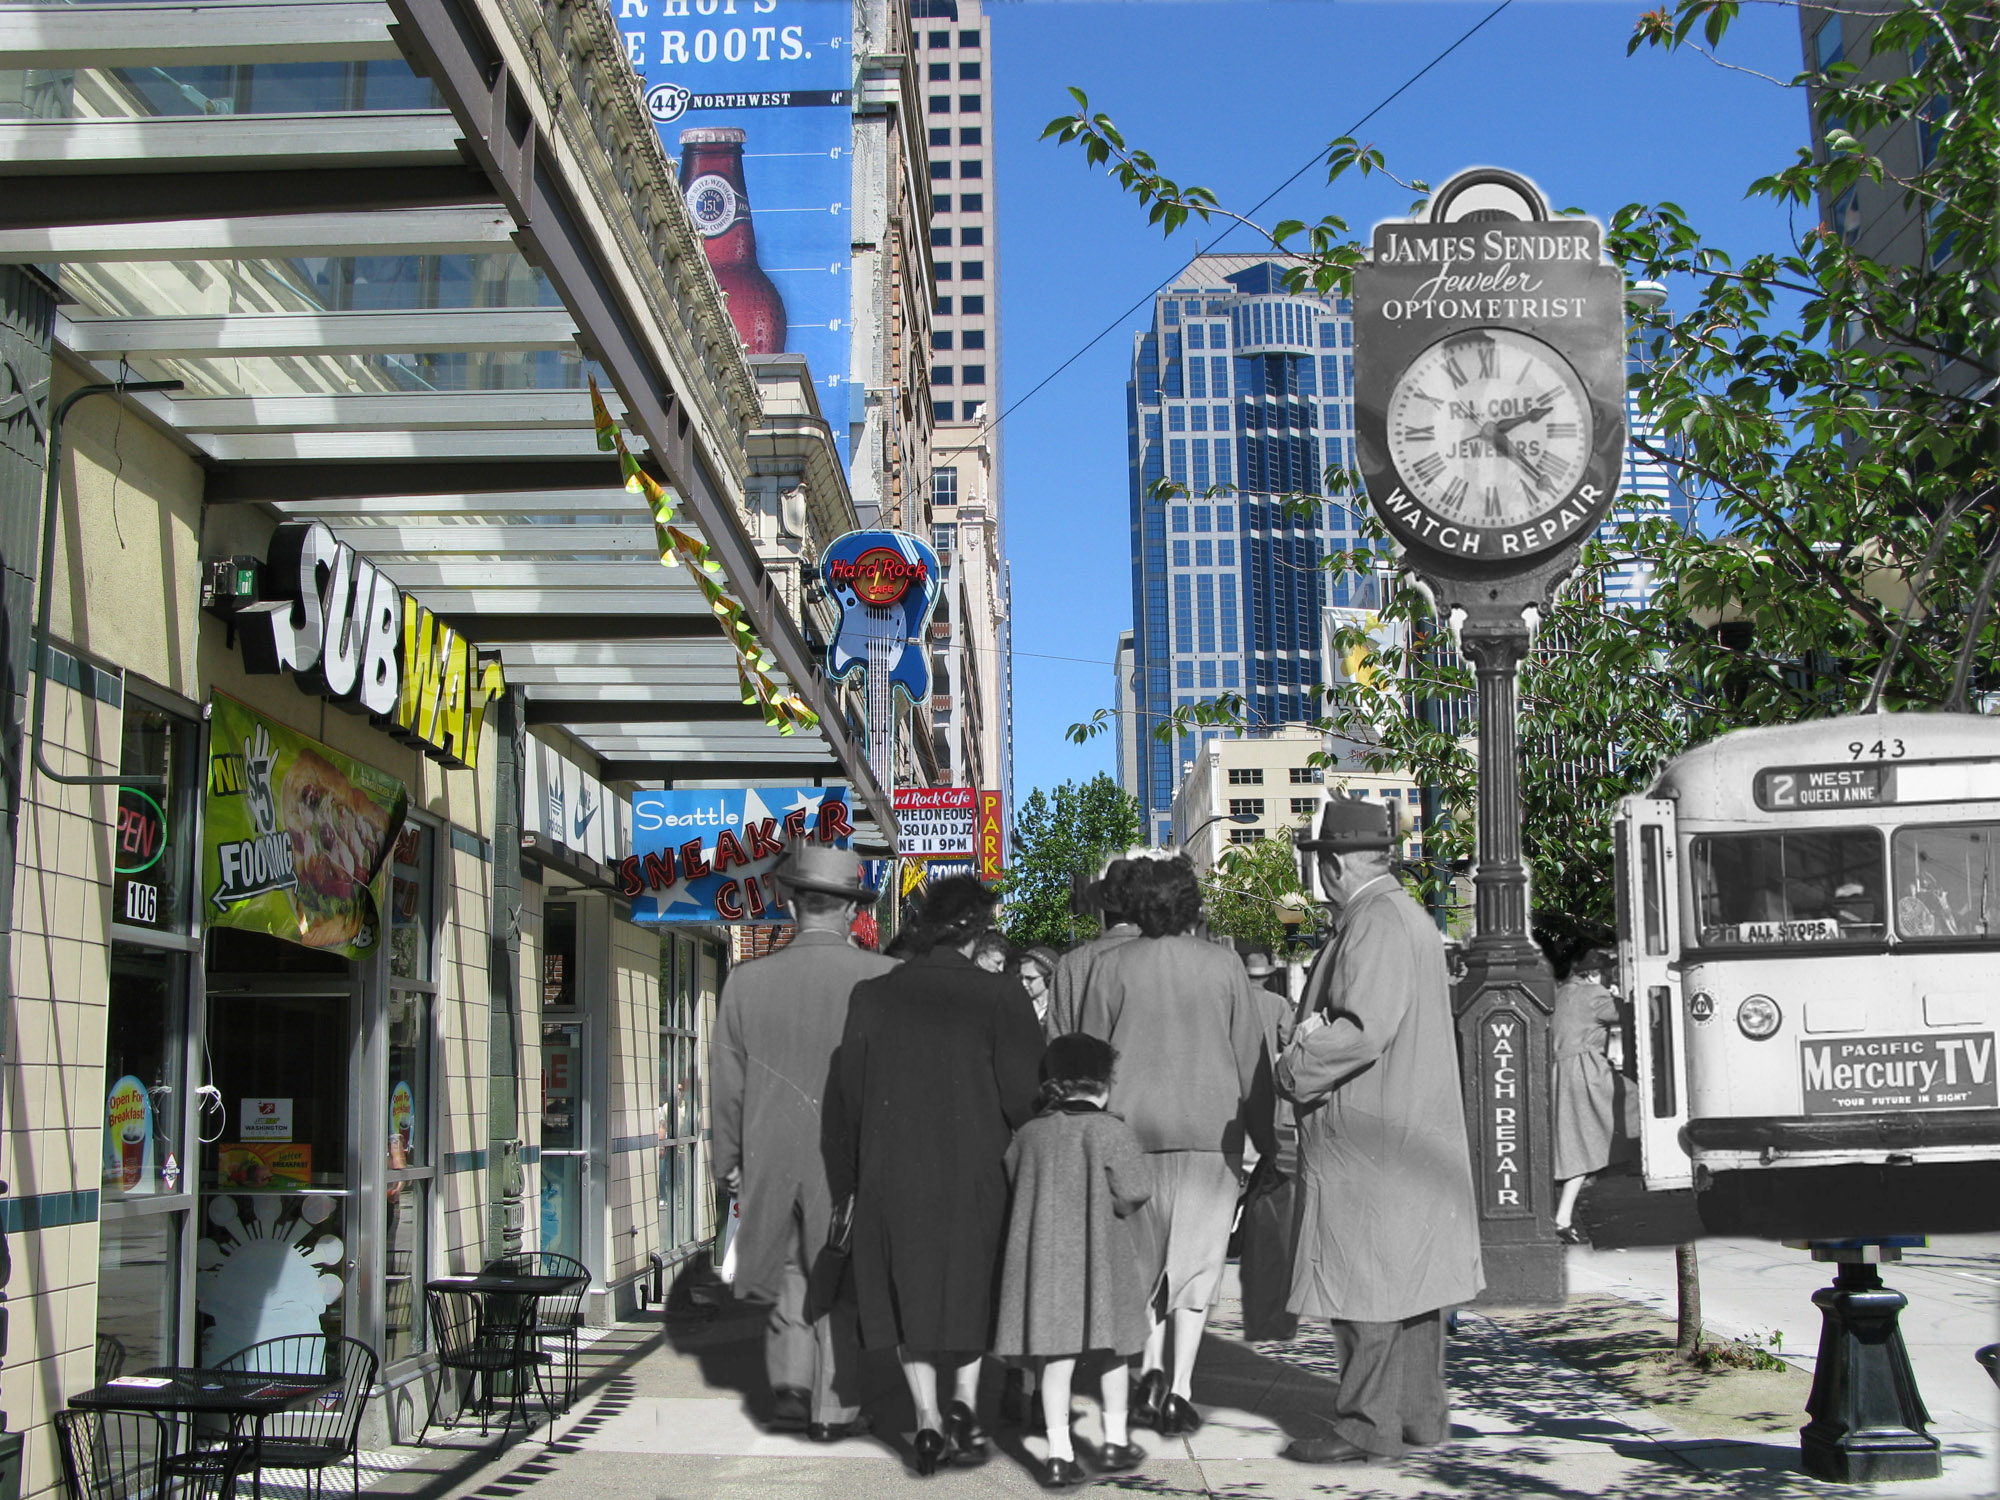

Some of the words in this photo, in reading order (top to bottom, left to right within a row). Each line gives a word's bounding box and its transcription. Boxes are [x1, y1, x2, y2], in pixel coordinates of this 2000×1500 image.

[660, 26, 812, 64] ROOTS.
[693, 93, 790, 108] NORTHWEST
[703, 200, 716, 212] 151
[1381, 233, 1475, 262] JAMES
[1484, 230, 1592, 260] SENDER
[1411, 262, 1543, 309] Jeweler
[1382, 297, 1586, 320] OPTOMETRIST
[1446, 440, 1540, 458] JEWERS
[1385, 487, 1480, 553] WATCH
[1502, 483, 1604, 553] REPAIR
[830, 558, 880, 578] Hard
[881, 558, 928, 581] Rock
[868, 585, 894, 594] CAFE
[250, 521, 506, 770] SUBWAY
[1848, 738, 1905, 760] 943
[1809, 771, 1864, 786] WEST
[895, 792, 910, 805] rd
[911, 791, 941, 807] Rock
[942, 790, 971, 806] Cafe
[1773, 775, 1795, 806] 2
[1800, 788, 1840, 804] QUEEN
[1843, 786, 1876, 801] ANNE
[635, 799, 739, 831] Seattle
[117, 805, 156, 858] PEN
[983, 796, 1000, 875] PARK
[620, 800, 856, 898] SNEAKER
[939, 838, 967, 851] 9PM
[130, 881, 156, 921] 106
[1748, 924, 1774, 939] ALL
[1778, 921, 1826, 940] STOPS
[1841, 1041, 1925, 1057] PACIFIC
[1490, 1023, 1516, 1098] WATCH
[1804, 1046, 1939, 1093] Mercury
[1935, 1038, 1992, 1085] TV
[110, 1094, 130, 1109] Open
[132, 1089, 145, 1102] For
[1871, 1095, 1912, 1106] FUTURE
[1918, 1094, 1930, 1103] IN
[108, 1107, 146, 1128] Breakfast!
[271, 1161, 308, 1169] BREAKFAST
[278, 1151, 303, 1161] better
[1495, 1107, 1519, 1205] REPAIR
